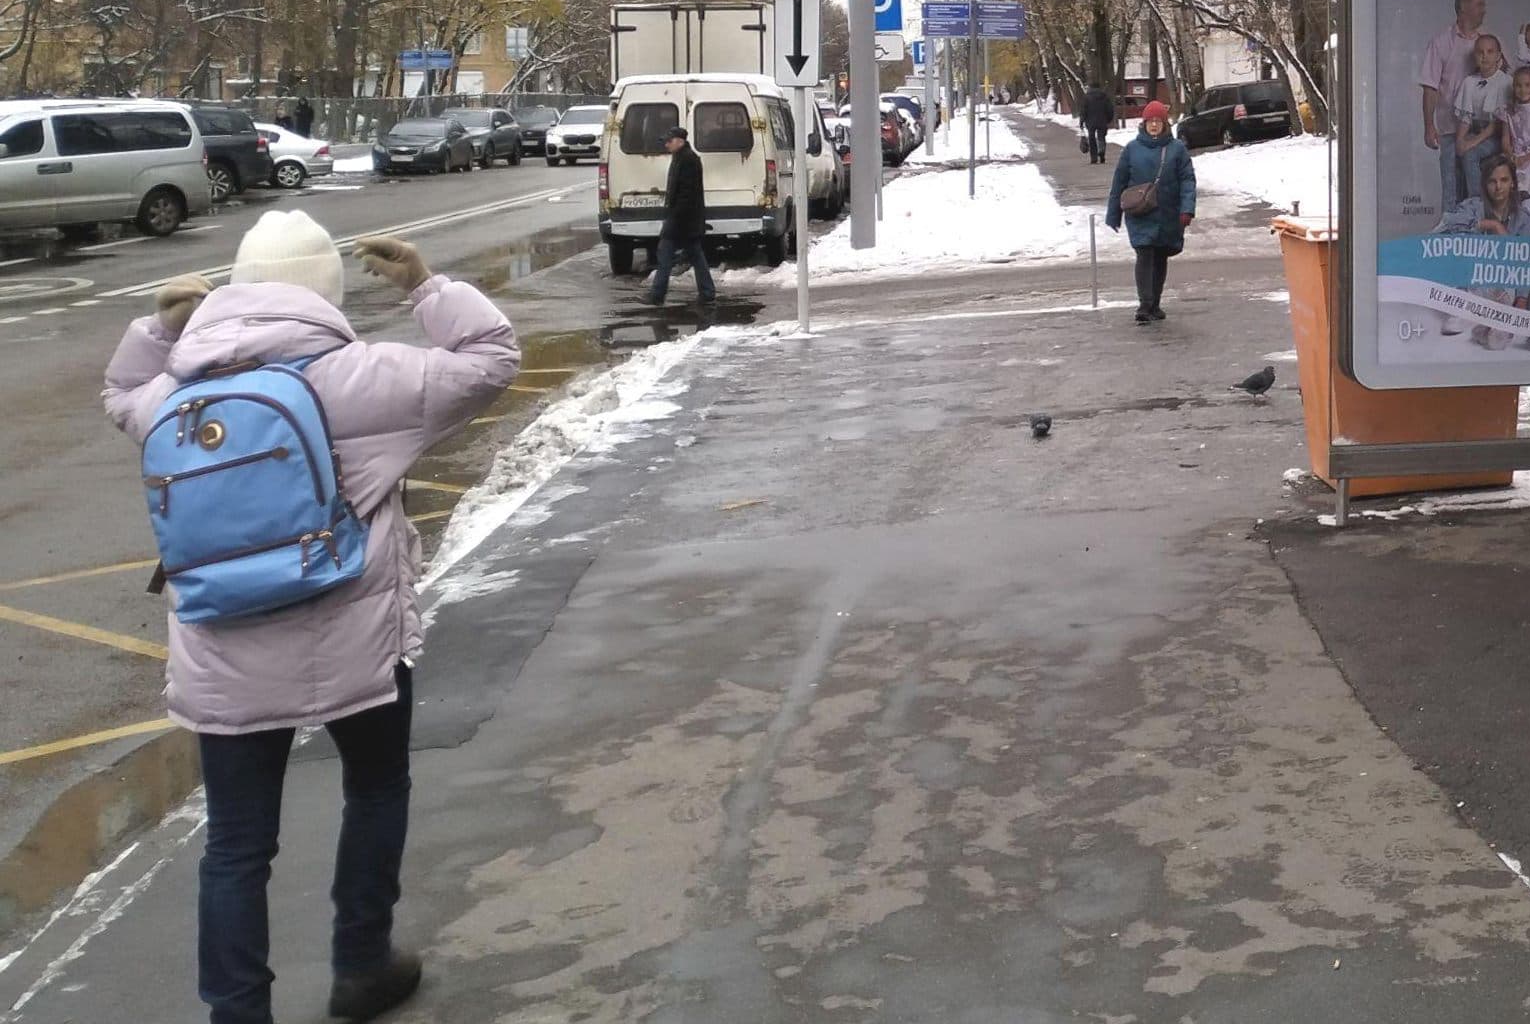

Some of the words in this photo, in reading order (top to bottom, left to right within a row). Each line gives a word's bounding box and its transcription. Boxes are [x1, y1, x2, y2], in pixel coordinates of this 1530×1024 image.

[1421, 236, 1499, 259] ХОРОШИХ
[1428, 287, 1442, 303] ВСЕ
[1443, 294, 1465, 309] МЕРЫ
[1512, 315, 1530, 328] ДЛЯ
[1400, 320, 1425, 340] 0+
